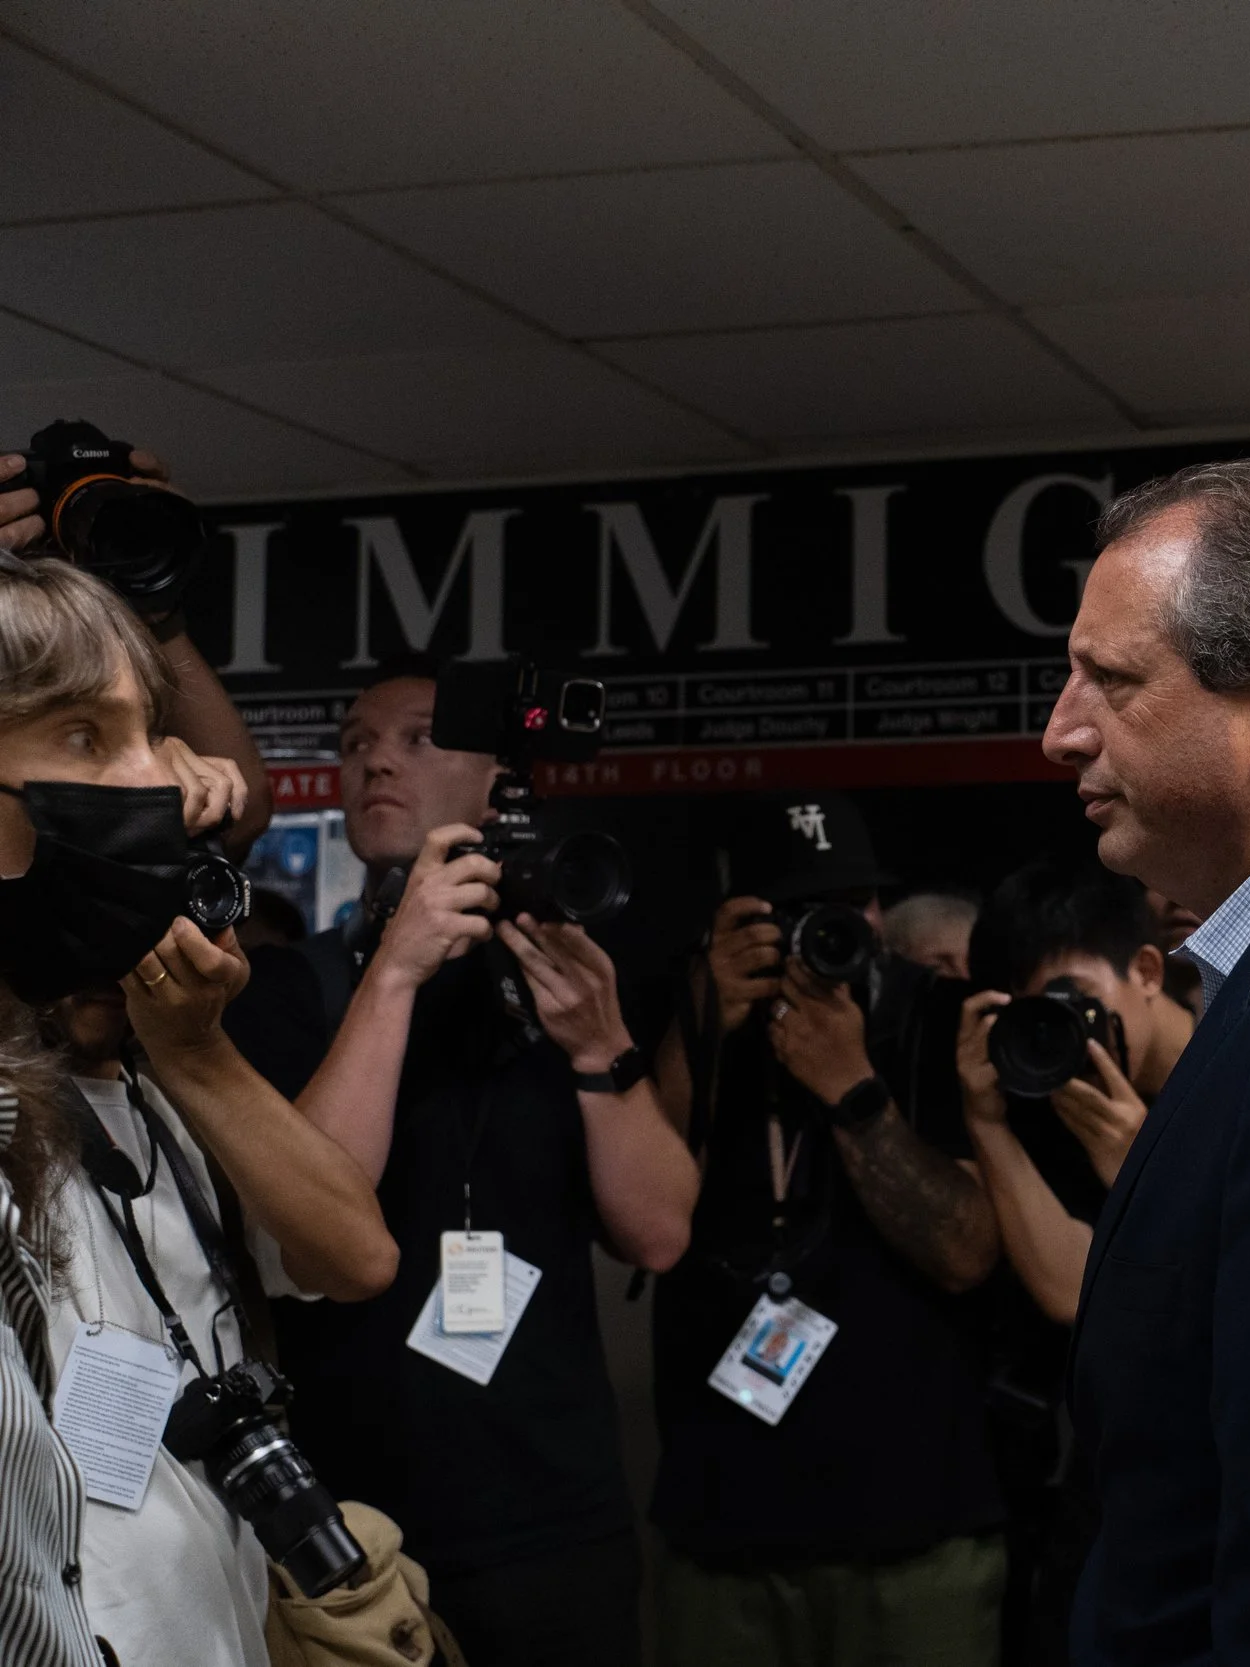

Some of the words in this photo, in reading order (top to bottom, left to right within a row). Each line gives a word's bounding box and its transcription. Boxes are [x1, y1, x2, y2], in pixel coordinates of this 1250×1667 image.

[72, 448, 111, 459] Canon
[697, 682, 810, 705] Courtroom
[240, 704, 326, 721] ourtroom
[545, 761, 621, 786] 14TH
[651, 756, 764, 783] FLOOR
